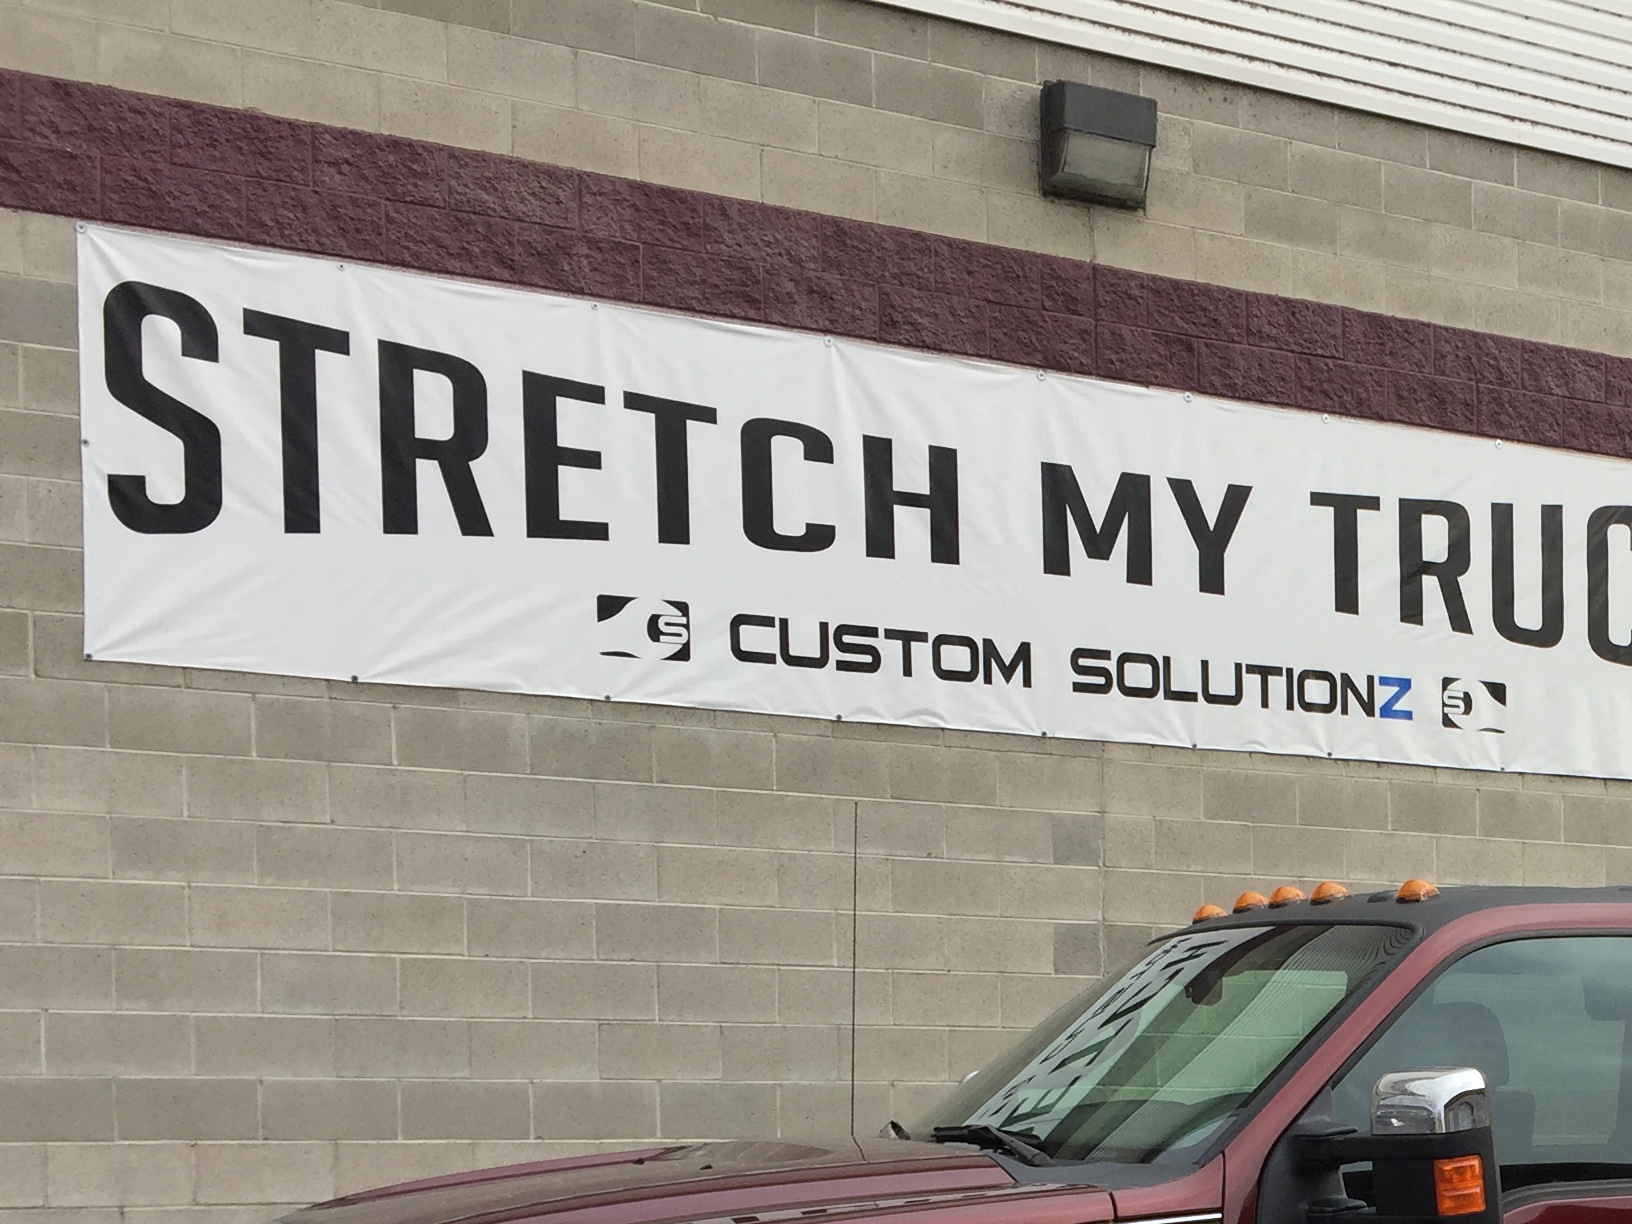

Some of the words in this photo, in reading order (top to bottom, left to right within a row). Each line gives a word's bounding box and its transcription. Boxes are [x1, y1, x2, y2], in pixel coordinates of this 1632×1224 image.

[103, 280, 960, 565] STRETCH
[1040, 461, 1253, 596] MY
[729, 613, 1032, 689] CUSTOM
[1070, 648, 1414, 721] SOLUTIONZ
